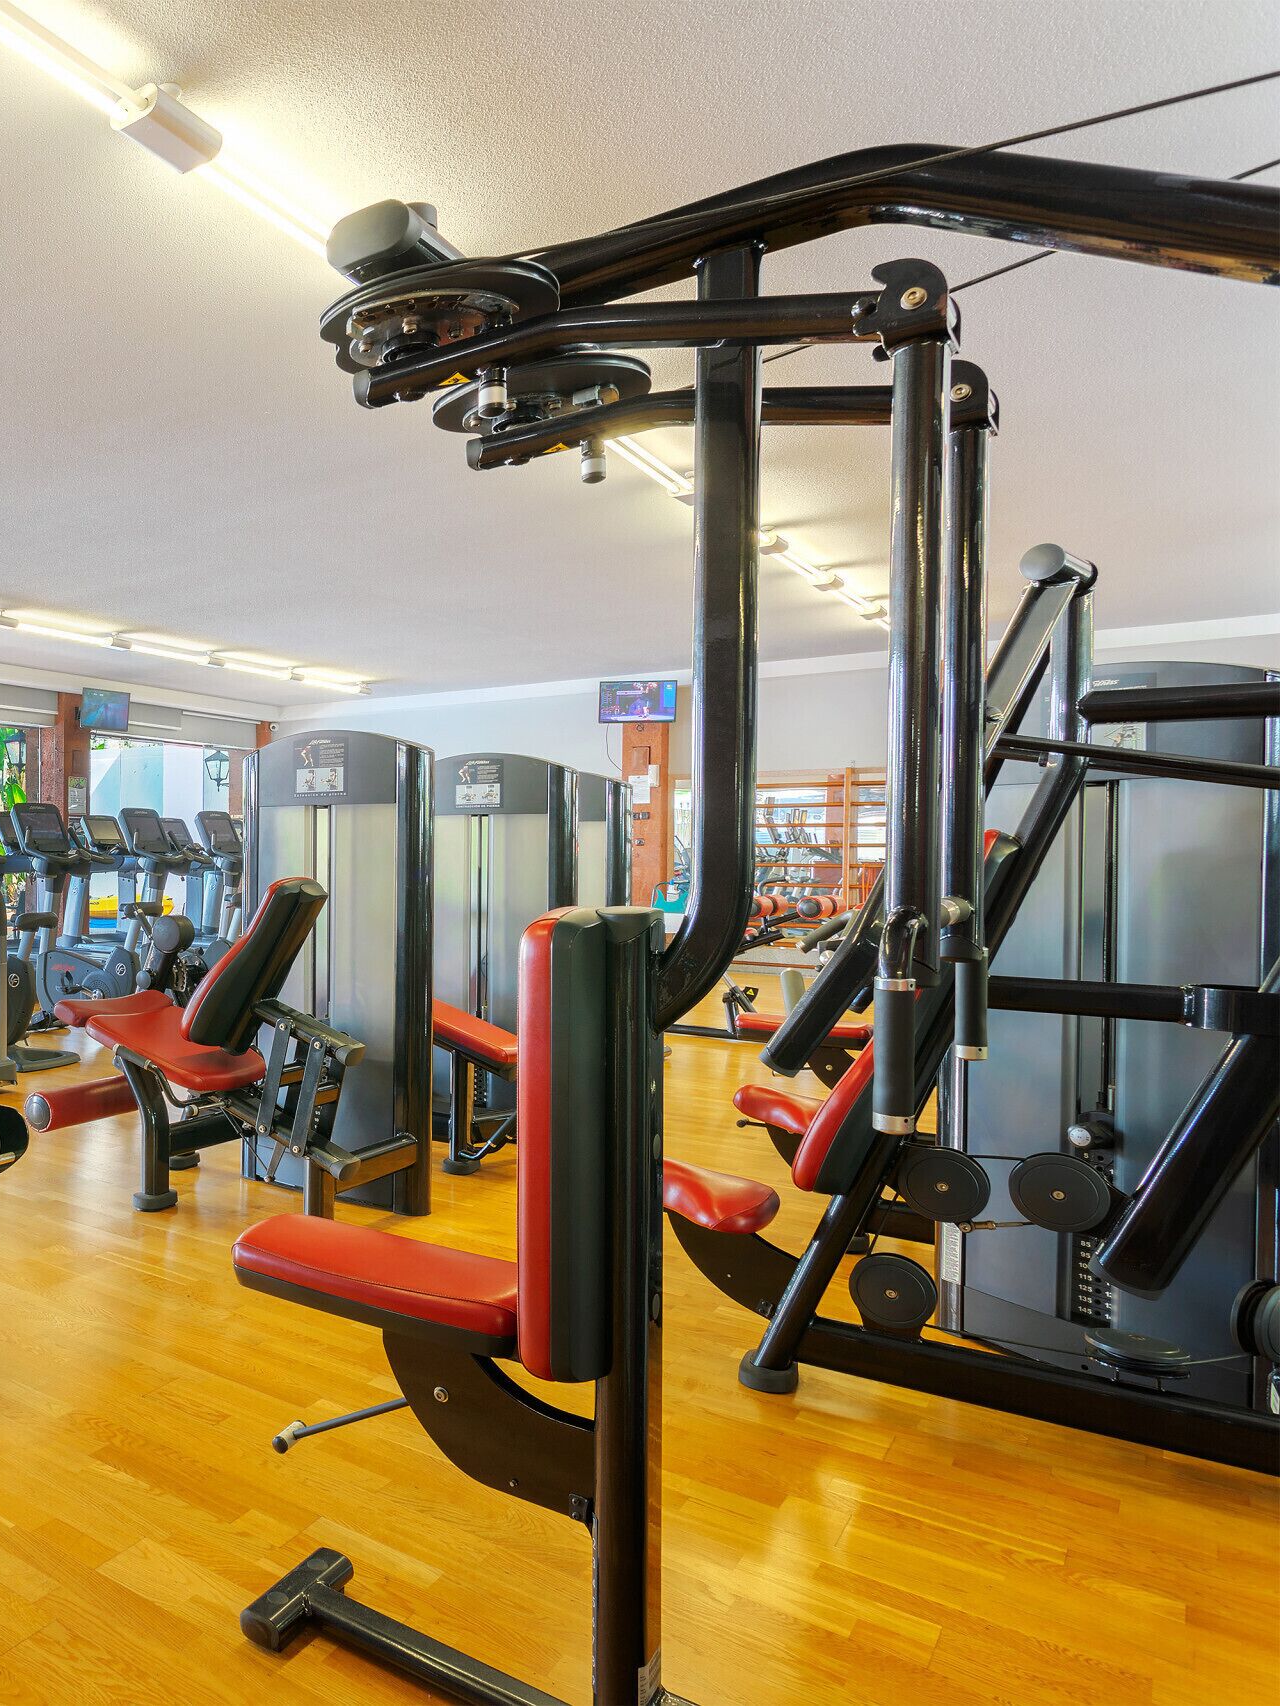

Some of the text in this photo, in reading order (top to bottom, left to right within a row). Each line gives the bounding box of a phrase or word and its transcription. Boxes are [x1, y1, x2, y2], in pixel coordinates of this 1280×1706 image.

[1080, 1240, 1091, 1248] 85
[1080, 1251, 1091, 1259] 95
[1078, 1273, 1093, 1281] 115
[1078, 1284, 1093, 1293] 125
[1078, 1295, 1093, 1304] 135
[1078, 1306, 1093, 1315] 145
